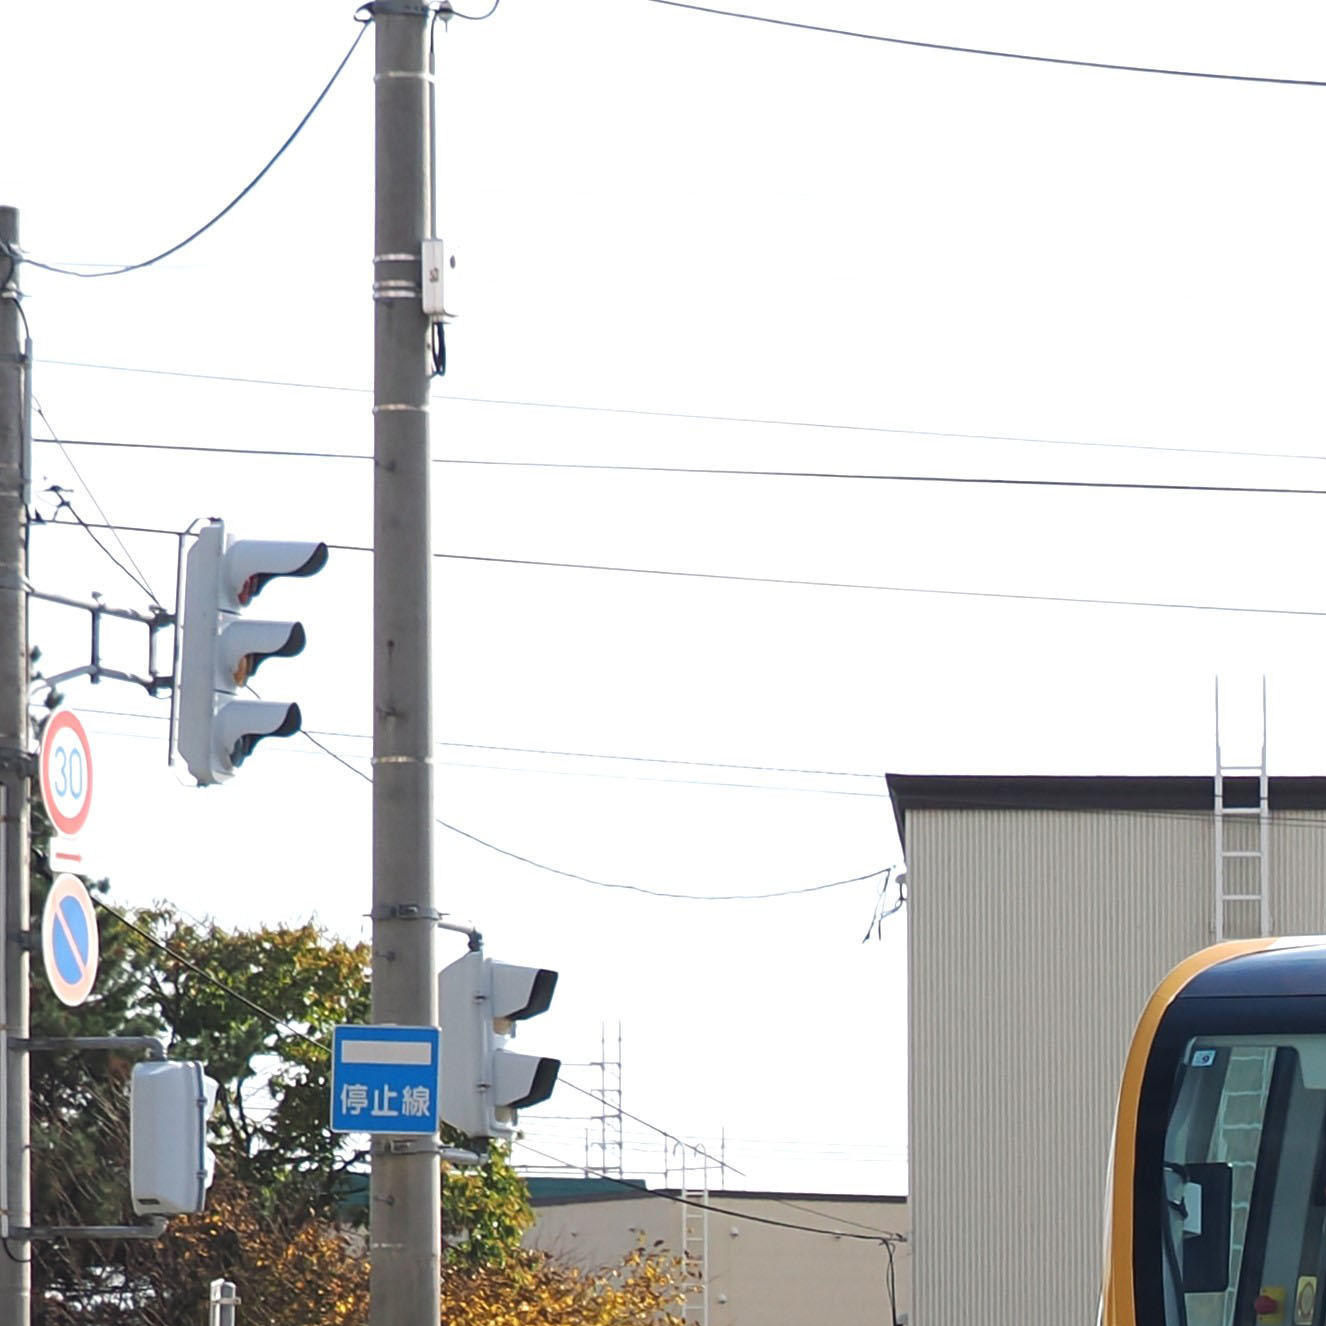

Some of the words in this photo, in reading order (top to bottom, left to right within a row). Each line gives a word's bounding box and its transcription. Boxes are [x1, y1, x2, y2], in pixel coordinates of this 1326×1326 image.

[54, 746, 82, 800] 30
[341, 1083, 431, 1117] 停止線
